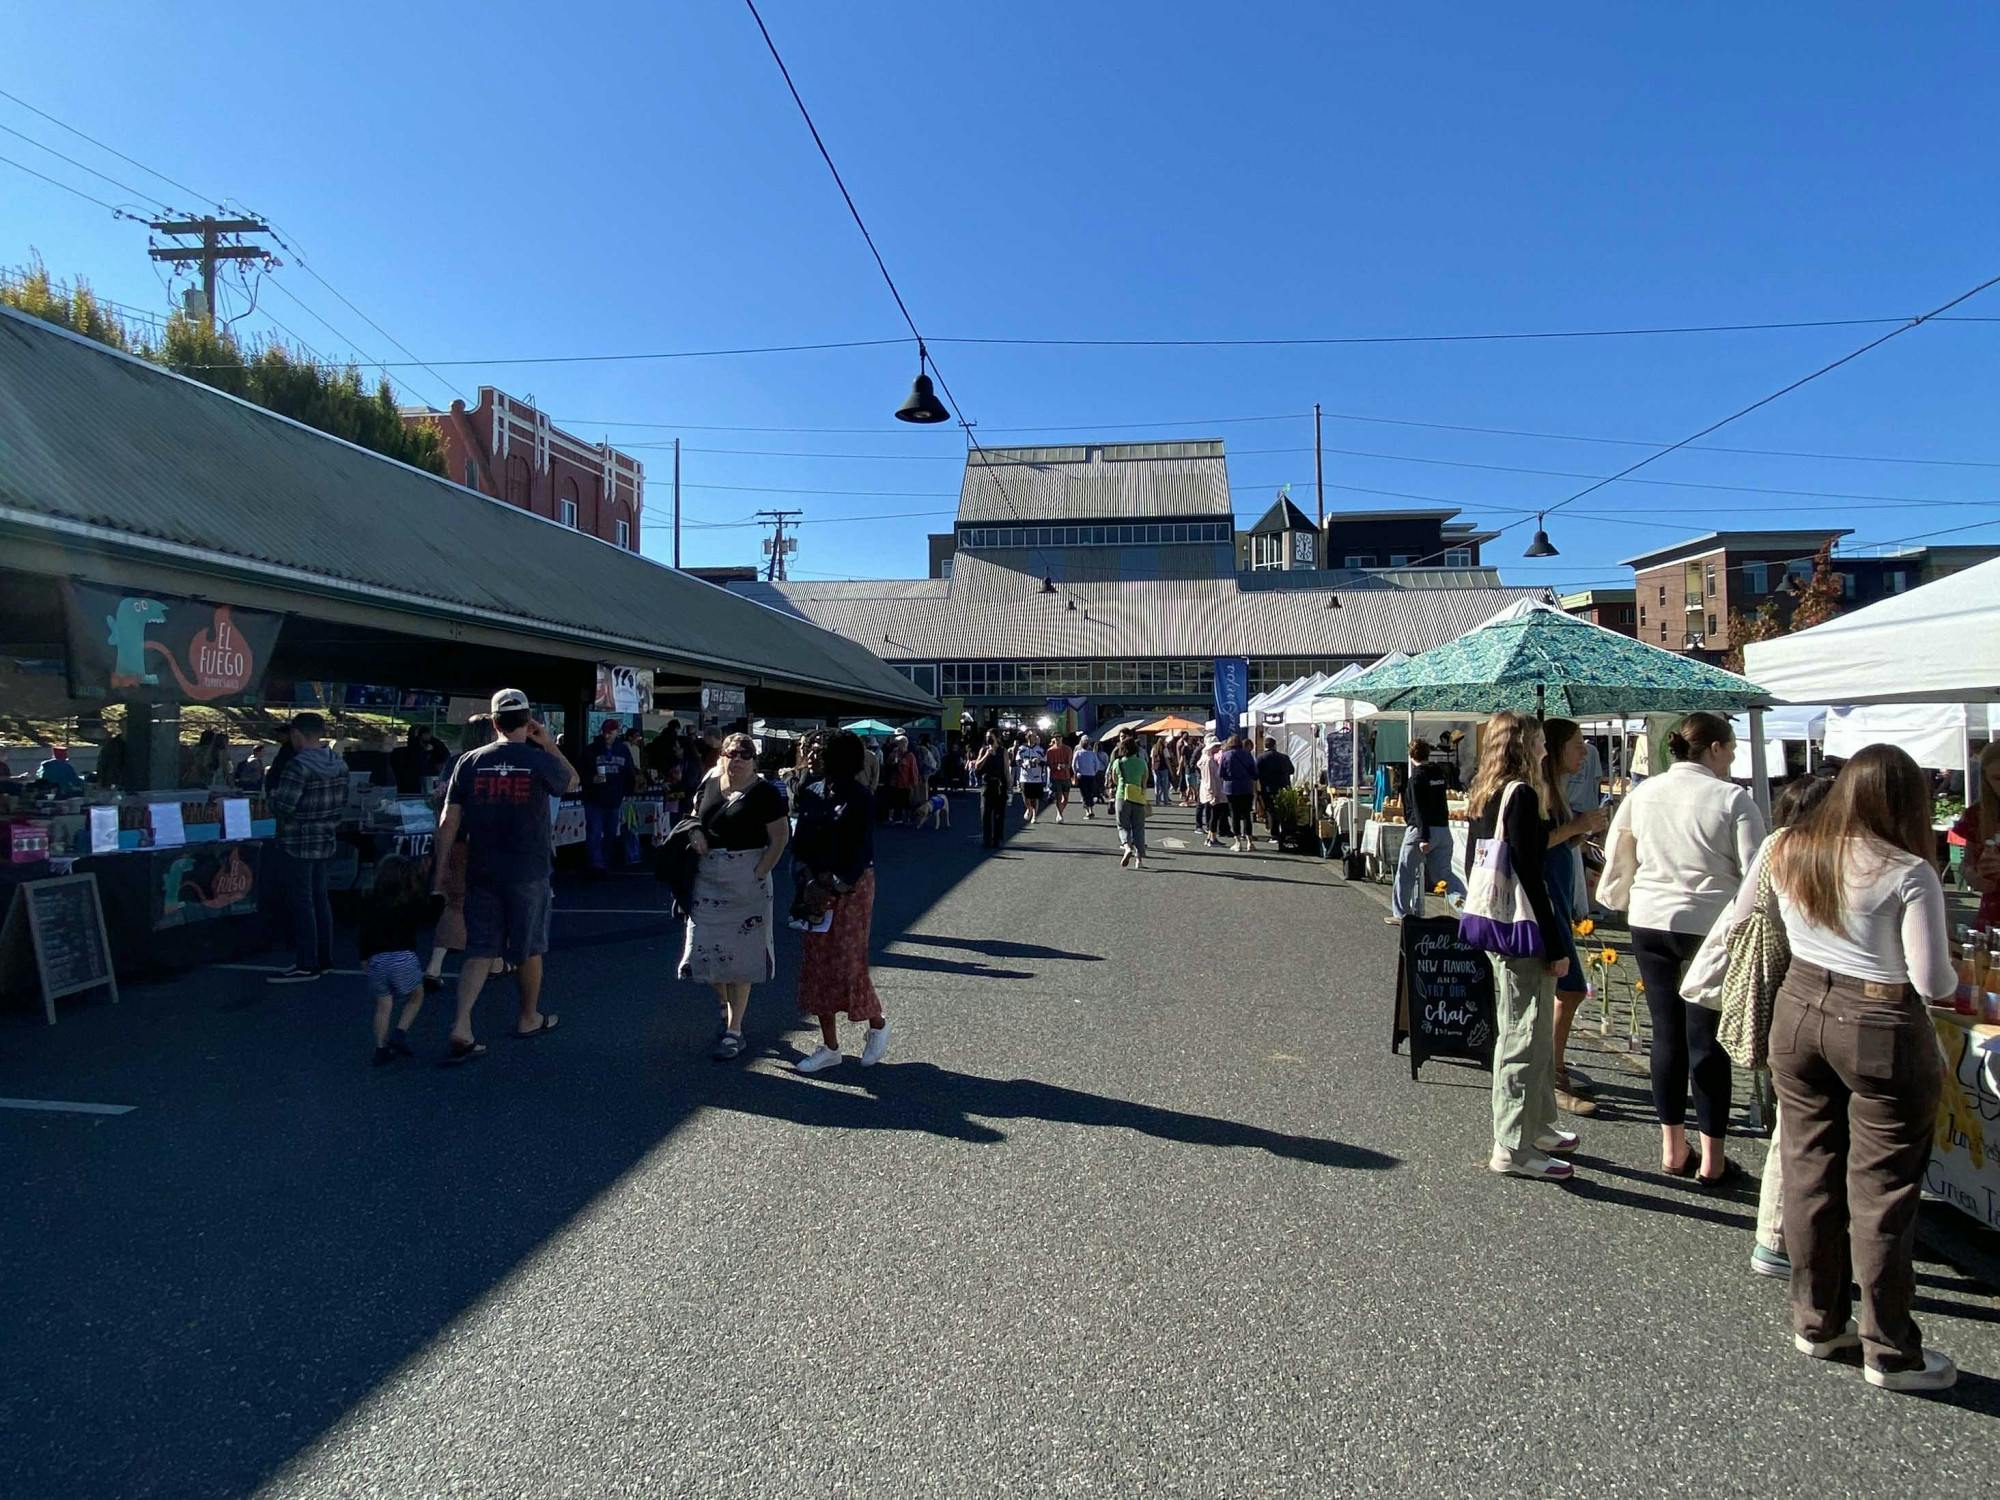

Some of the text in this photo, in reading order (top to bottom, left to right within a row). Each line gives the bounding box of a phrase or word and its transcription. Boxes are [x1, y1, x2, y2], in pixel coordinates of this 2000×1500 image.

[218, 622, 232, 651] EL
[199, 646, 244, 676] FUEGO
[474, 777, 530, 798] FIRE
[1418, 959, 1477, 974] NEW FLAVORS
[1437, 976, 1458, 984] AND
[1449, 984, 1467, 999] OUR
